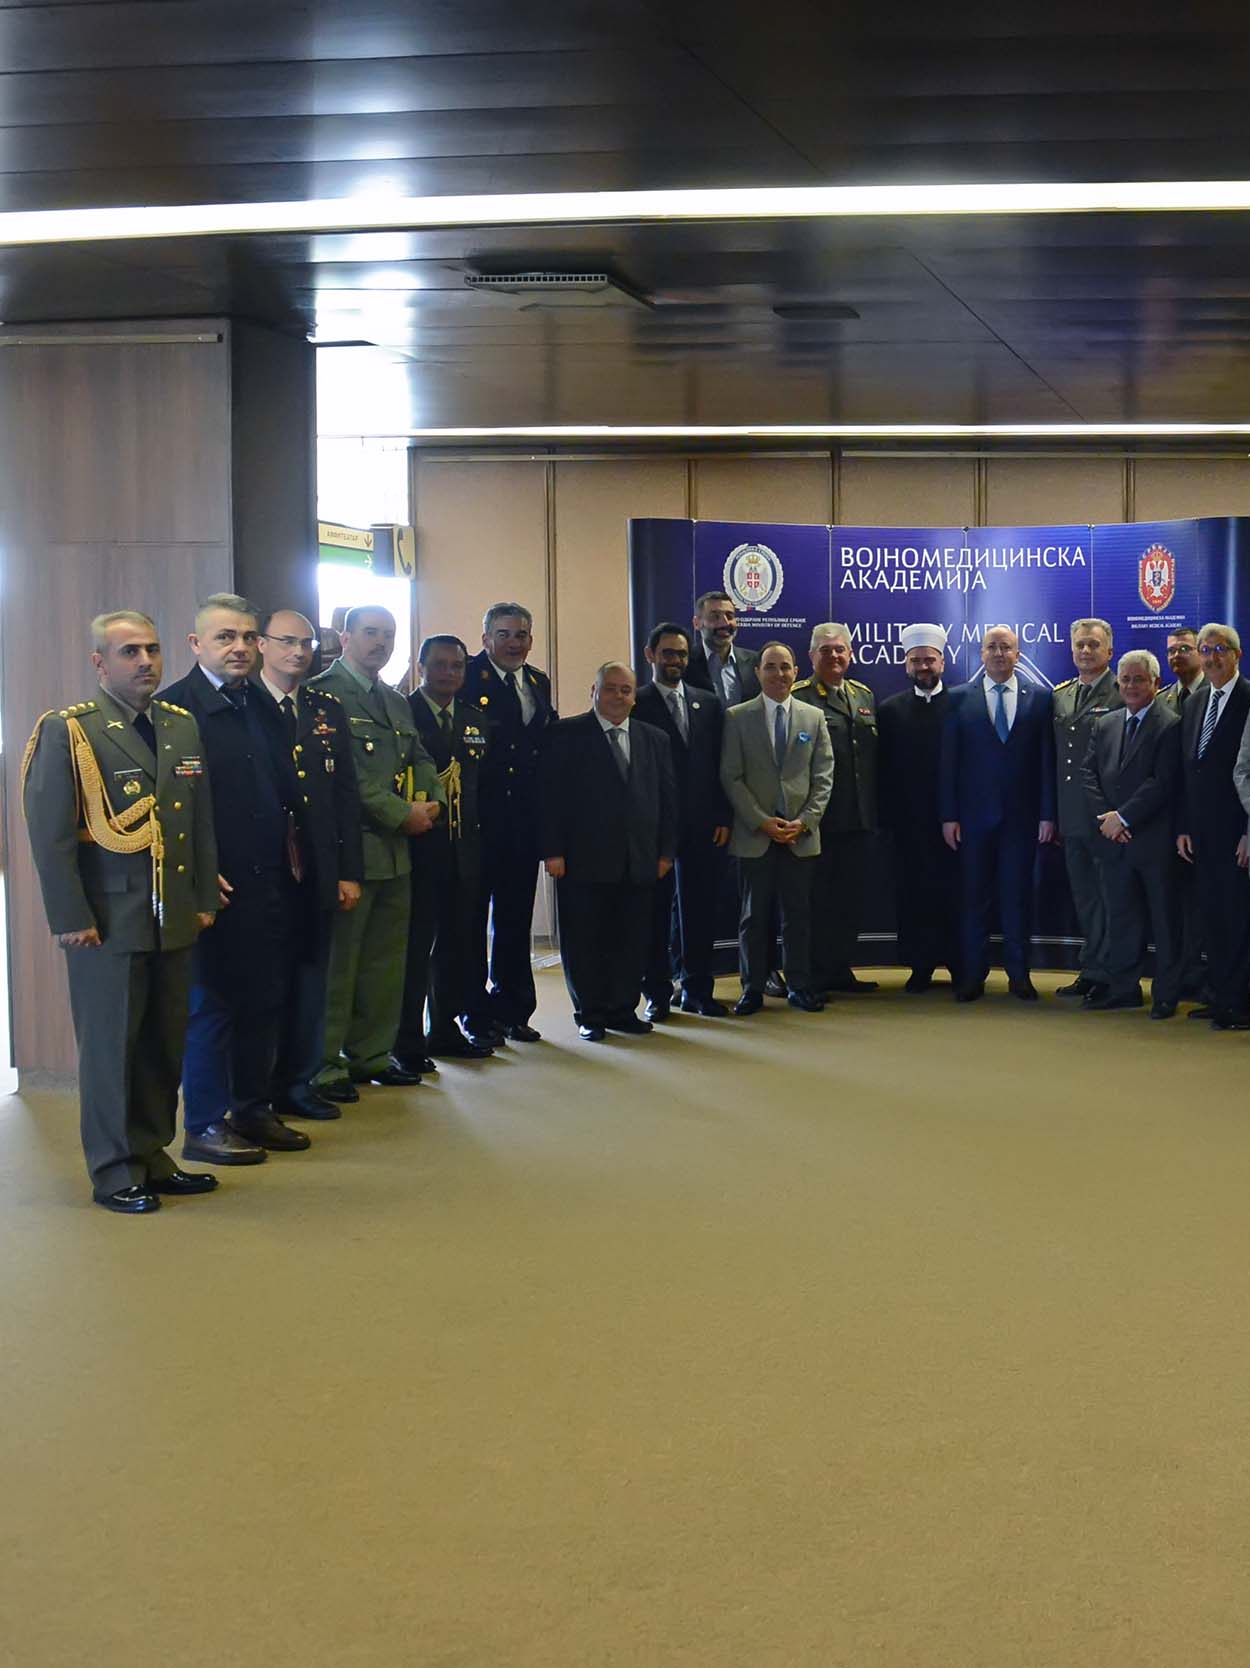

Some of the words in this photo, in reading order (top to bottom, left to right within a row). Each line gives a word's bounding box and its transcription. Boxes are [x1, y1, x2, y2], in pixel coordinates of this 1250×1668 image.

[841, 546, 1086, 572] ВОЈНОМЕДИЦИНСКА
[840, 569, 987, 593] АКАДЕМИЈА
[844, 622, 952, 643] MILITY
[961, 622, 1064, 643] MICAL
[850, 645, 961, 665] CADY
